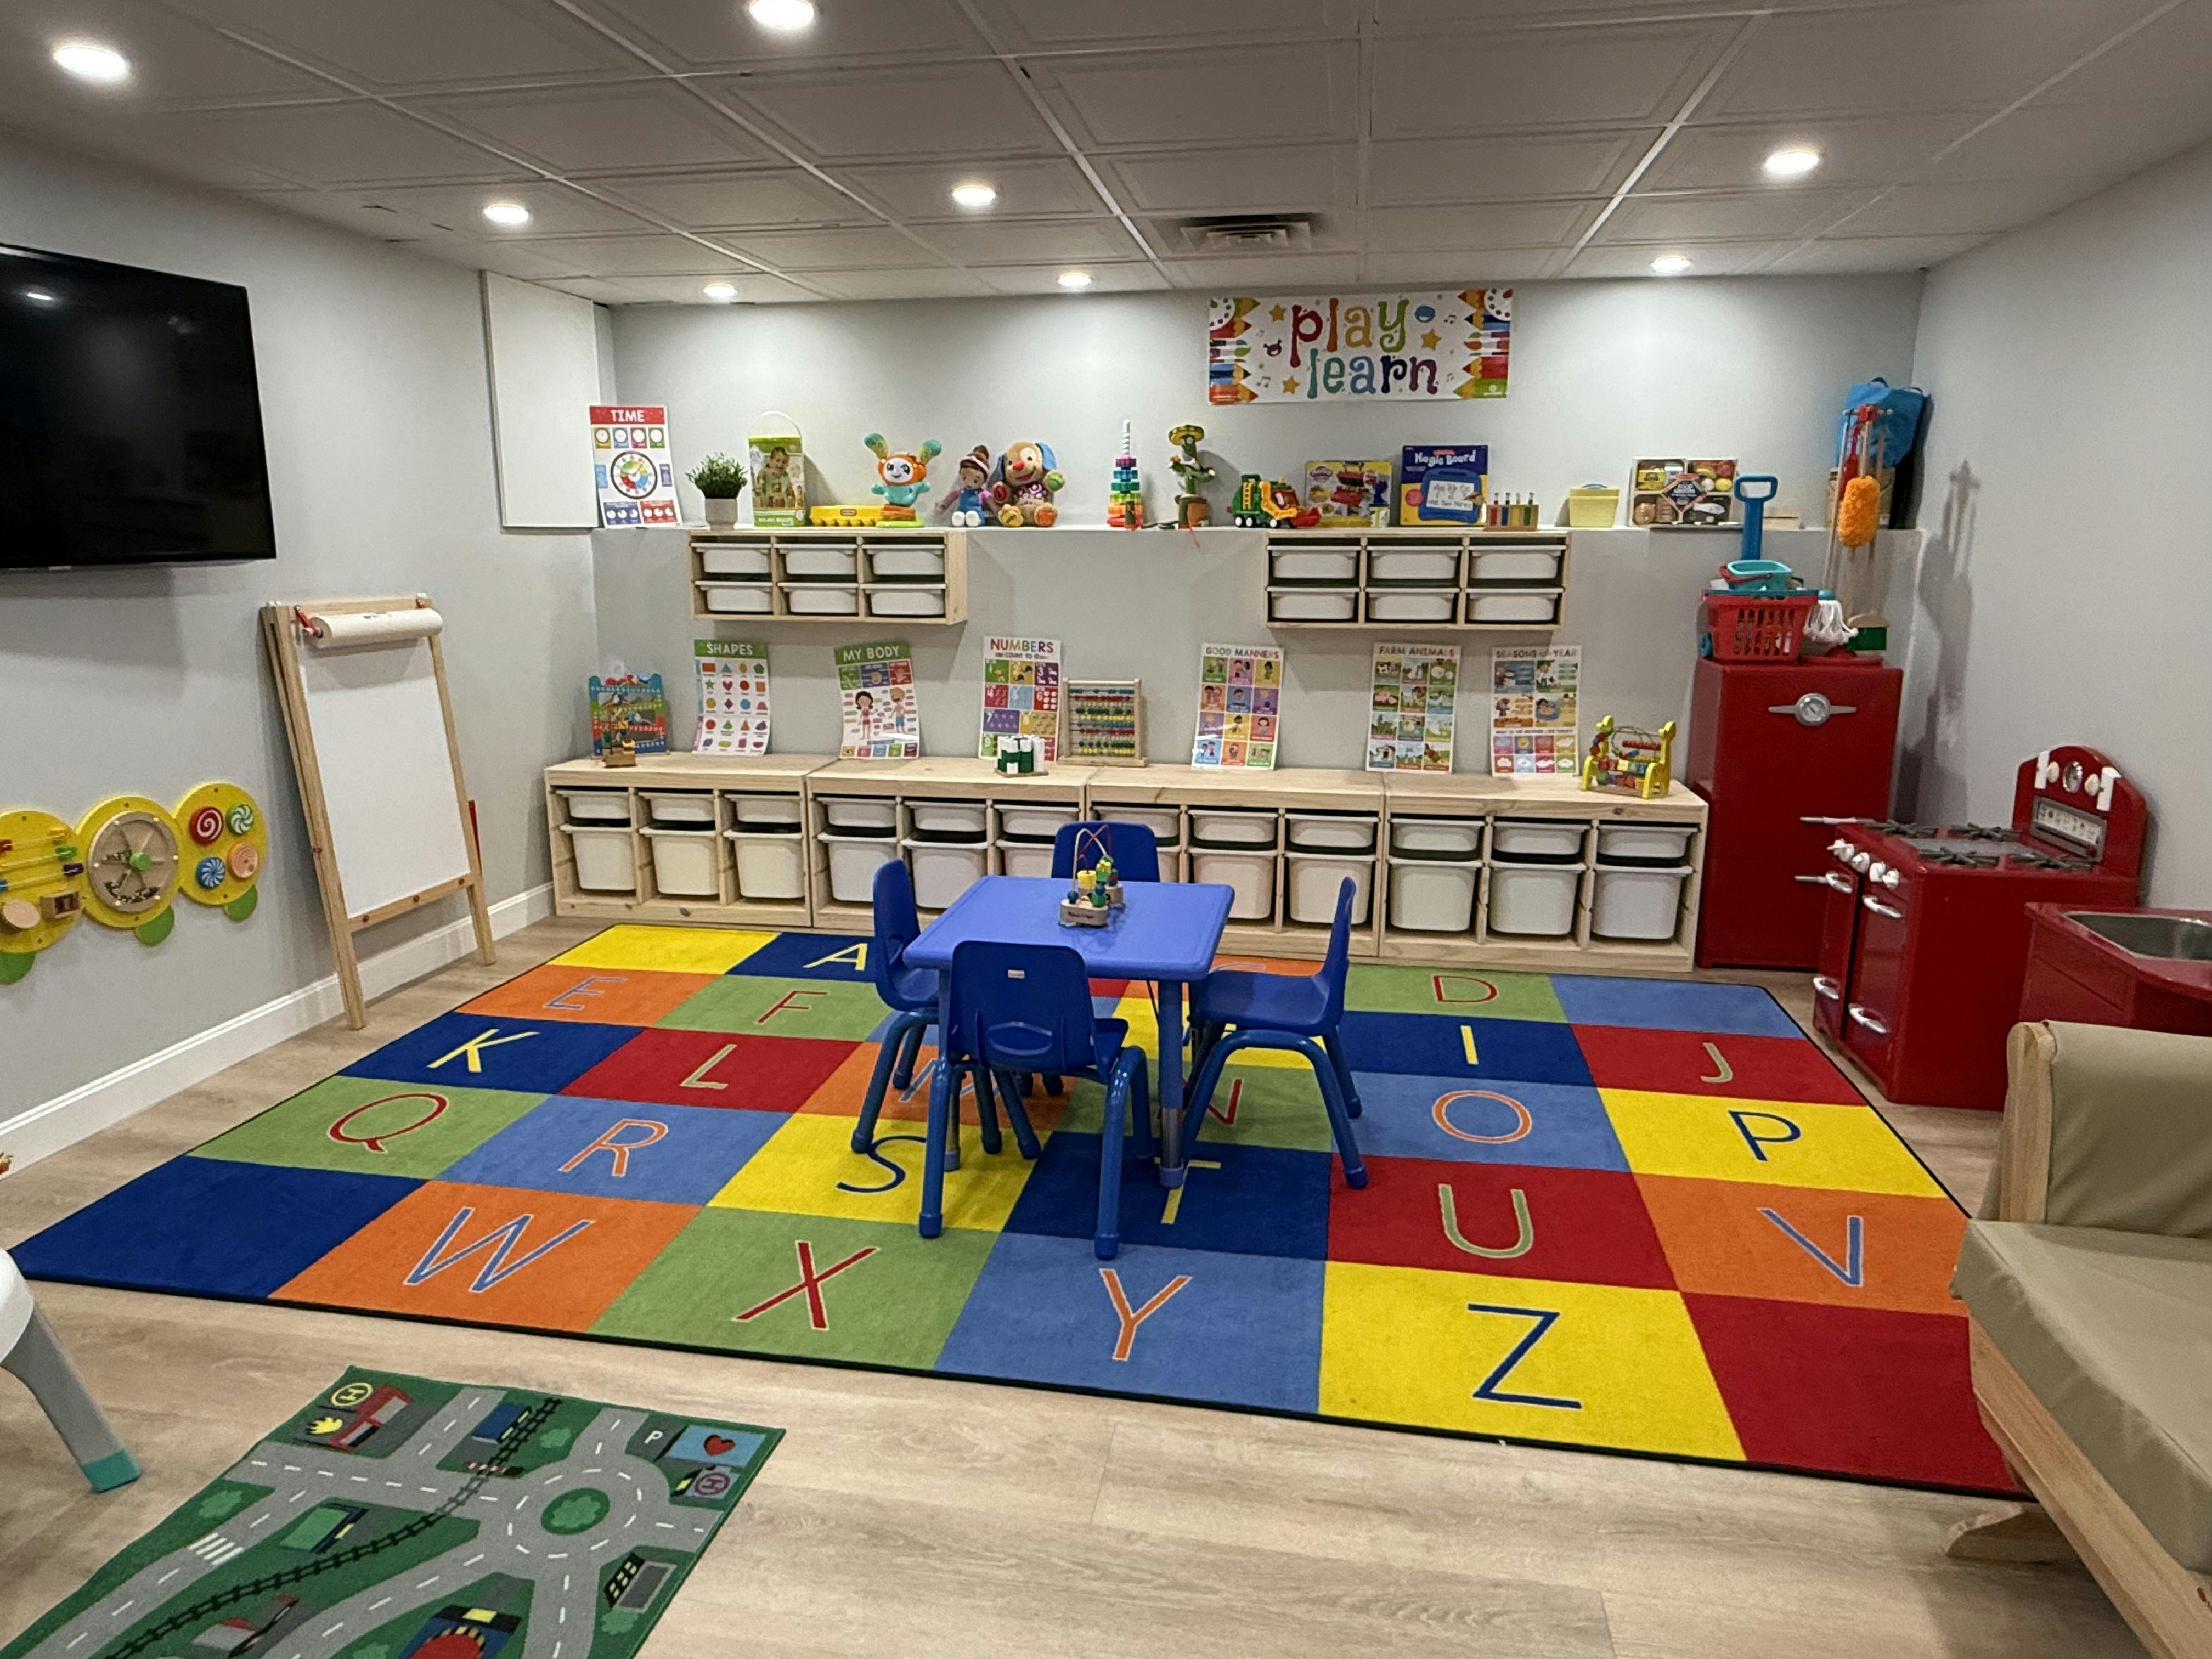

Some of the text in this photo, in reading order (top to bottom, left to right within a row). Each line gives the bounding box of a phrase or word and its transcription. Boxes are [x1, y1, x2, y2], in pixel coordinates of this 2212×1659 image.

[1290, 298, 1409, 368] play
[1307, 348, 1438, 399] learn
[610, 409, 645, 422] TIME
[1446, 450, 1477, 465] Board
[707, 642, 753, 655] SHAPES
[843, 645, 899, 662] MY BODY
[990, 638, 1054, 653] NUMBERS
[1206, 647, 1231, 656] GOOD
[1379, 646, 1406, 655] FARM
[1037, 666, 1044, 677] 3
[987, 689, 994, 698] 4
[1036, 691, 1043, 702] 6
[986, 712, 993, 723] 7
[984, 736, 991, 747] 9
[802, 943, 868, 972] A
[543, 977, 627, 1011] E
[755, 990, 828, 1024] F
[1431, 974, 1498, 1003] D
[426, 1028, 540, 1073] K
[1460, 1025, 1479, 1065] I
[1700, 1042, 1733, 1083] J
[679, 1043, 737, 1090] L
[326, 1093, 449, 1154] Q
[1432, 1090, 1533, 1143] O
[558, 1118, 669, 1176] R
[1728, 1110, 1802, 1162] P
[835, 1135, 927, 1193] S
[1438, 1183, 1534, 1259] U
[403, 1207, 595, 1293] W
[1756, 1207, 1864, 1287] V
[731, 1239, 881, 1330] X
[1098, 1268, 1192, 1361] Y
[1467, 1302, 1582, 1409] Z
[644, 1430, 663, 1444] P
